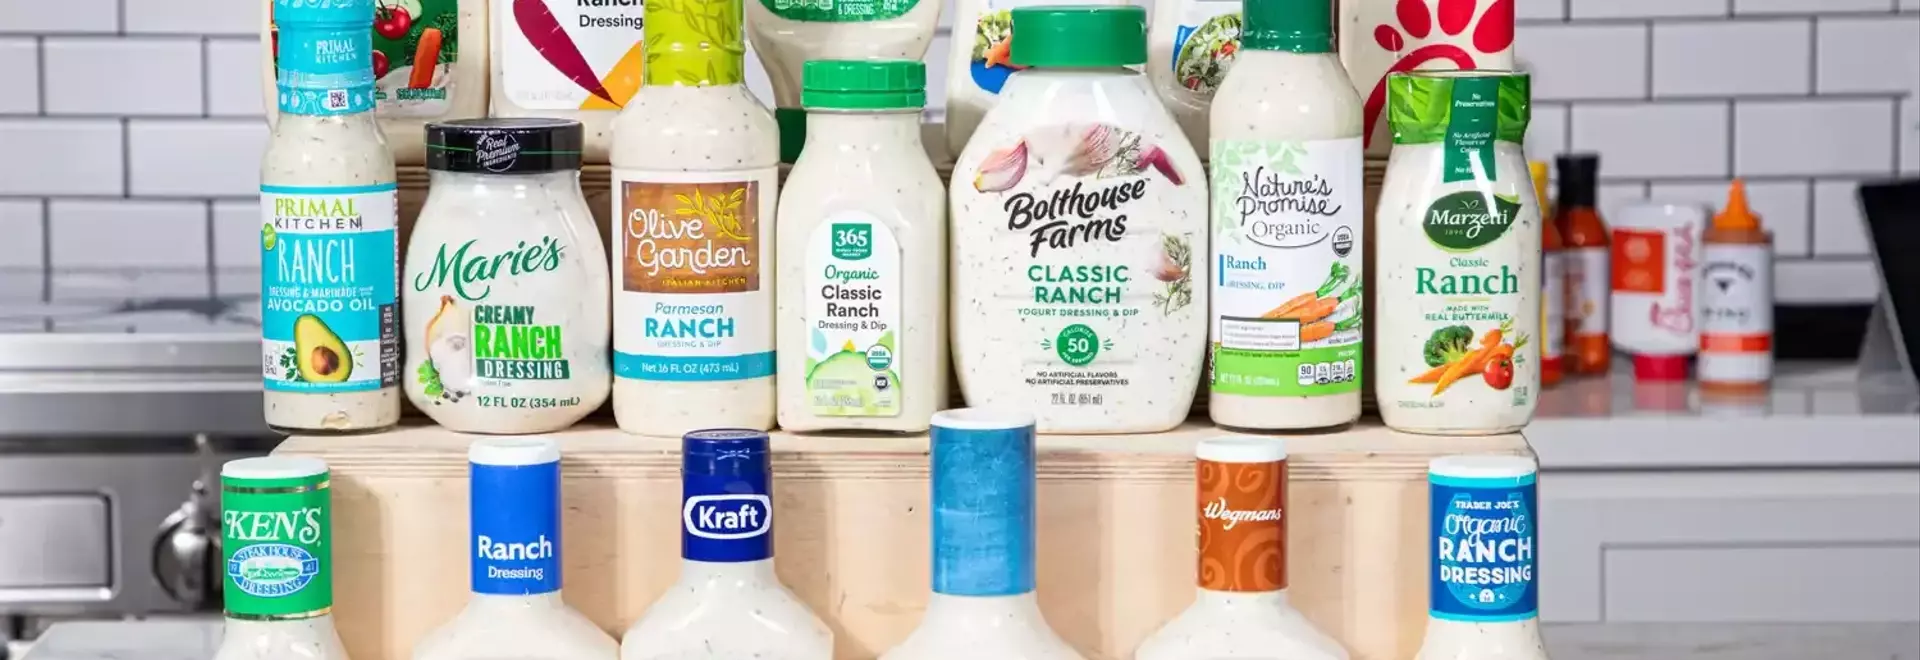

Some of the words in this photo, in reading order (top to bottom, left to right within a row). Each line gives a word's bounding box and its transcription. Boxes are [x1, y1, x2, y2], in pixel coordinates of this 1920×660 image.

[844, 4, 875, 15] DRESSING
[580, 14, 643, 30] Dressing
[316, 38, 355, 55] PRIMAL
[315, 53, 357, 63] KITCHEN
[485, 134, 508, 151] Real
[476, 143, 520, 163] Premium
[1243, 166, 1332, 198] Nature's
[275, 198, 359, 216] PRIMAL
[1004, 178, 1146, 230] Bolthouse
[1236, 196, 1342, 227] Promise
[275, 218, 360, 229] KITCHEN
[628, 208, 705, 240] Olive
[1252, 219, 1320, 241] Organic
[1430, 209, 1508, 239] Marzetti
[835, 228, 868, 247] 365
[1029, 214, 1127, 258] Farms
[278, 237, 355, 283] RANCH
[637, 239, 751, 276] Garden
[1226, 255, 1267, 270] Ranch
[1449, 257, 1489, 267] Classic
[415, 235, 566, 301] Marie's
[824, 264, 880, 284] Organic
[1027, 265, 1130, 283] CLASSIC
[662, 277, 701, 287] ITALIAN
[705, 276, 747, 286] KITCHEN
[1268, 281, 1285, 289] DIP
[1415, 265, 1519, 295] Ranch
[821, 285, 882, 300] Classic
[1035, 286, 1121, 304] RANCH
[267, 298, 344, 312] AVOCADO
[349, 298, 376, 311] OIL
[655, 302, 724, 315] Parmesan
[826, 302, 879, 317] Ranch
[1017, 308, 1057, 316] YOGURT
[1060, 309, 1109, 317] DRESSING
[1113, 309, 1120, 317] &
[1123, 309, 1139, 317] DIP
[474, 305, 535, 325] CREAMY
[1425, 312, 1448, 321] REAL
[1451, 312, 1509, 321] BUTTERMILK
[645, 317, 734, 338] RANCH
[818, 320, 858, 331] Dressing
[860, 320, 867, 329] &
[870, 320, 887, 331] Dip
[474, 325, 562, 359] RANCH
[657, 340, 697, 348] DRESSING
[1067, 338, 1090, 353] 50
[484, 359, 563, 379] DRESSING
[642, 363, 657, 373] Net
[658, 363, 669, 373] 16
[670, 363, 682, 373] FL
[683, 363, 698, 373] OZ
[700, 362, 720, 375] (473
[722, 362, 739, 373] mL)
[1301, 365, 1312, 375] 90
[477, 396, 490, 407] 12
[493, 396, 507, 407] FL
[511, 397, 526, 408] OZ
[529, 397, 556, 409] (354
[560, 396, 580, 407] mL)
[1203, 496, 1282, 531] Wegmans
[1454, 500, 1492, 509] TRADER
[1494, 500, 1520, 509] JOE'S
[224, 507, 322, 544] KEN'S
[699, 504, 759, 529] Kraft
[1445, 514, 1526, 547] Organic
[239, 546, 267, 561] STEAK
[478, 534, 552, 560] Ranch
[1438, 536, 1532, 563] RANCH
[487, 565, 544, 580] Dressing
[1440, 565, 1532, 585] DRESSING
[243, 579, 302, 595] DRESSING
